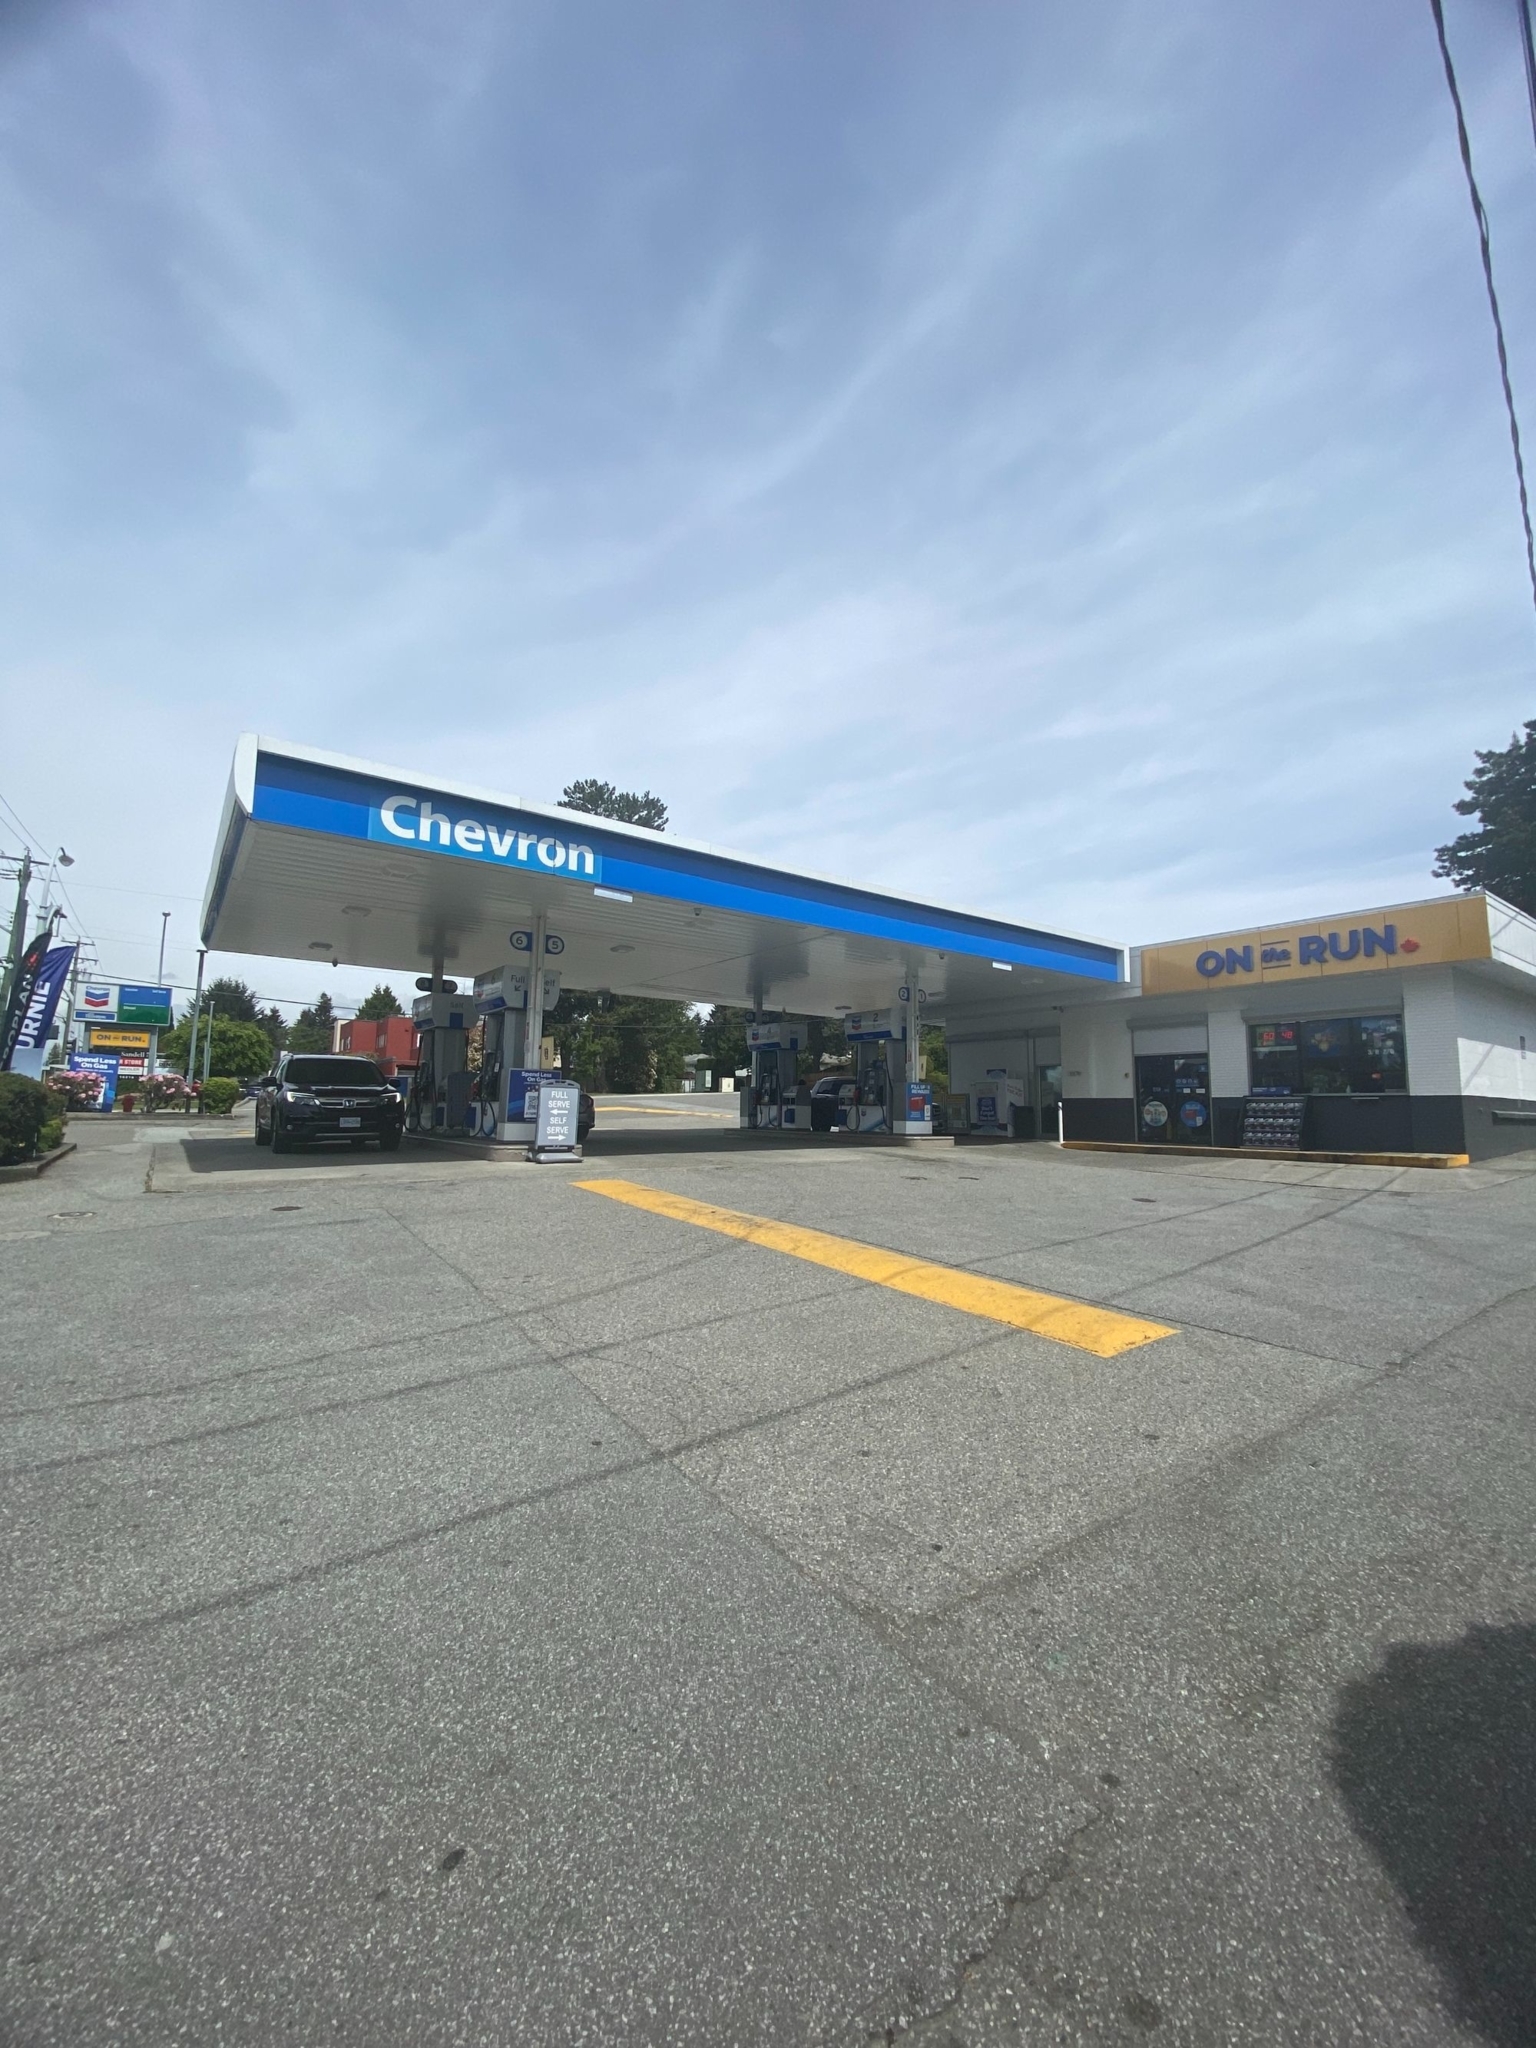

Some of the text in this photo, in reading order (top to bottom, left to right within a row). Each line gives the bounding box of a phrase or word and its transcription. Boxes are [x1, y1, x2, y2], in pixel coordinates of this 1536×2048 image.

[380, 796, 594, 875] Chevron
[516, 936, 523, 945] 6
[551, 940, 558, 950] 5
[1196, 924, 1396, 977] ON the RUN
[511, 975, 525, 983] Full
[873, 1013, 879, 1022] 2
[74, 1056, 99, 1065] Spend
[100, 1057, 117, 1065] Less
[551, 1090, 568, 1099] FULL
[548, 1100, 570, 1108] SERVE
[546, 1126, 569, 1134] SERVE
